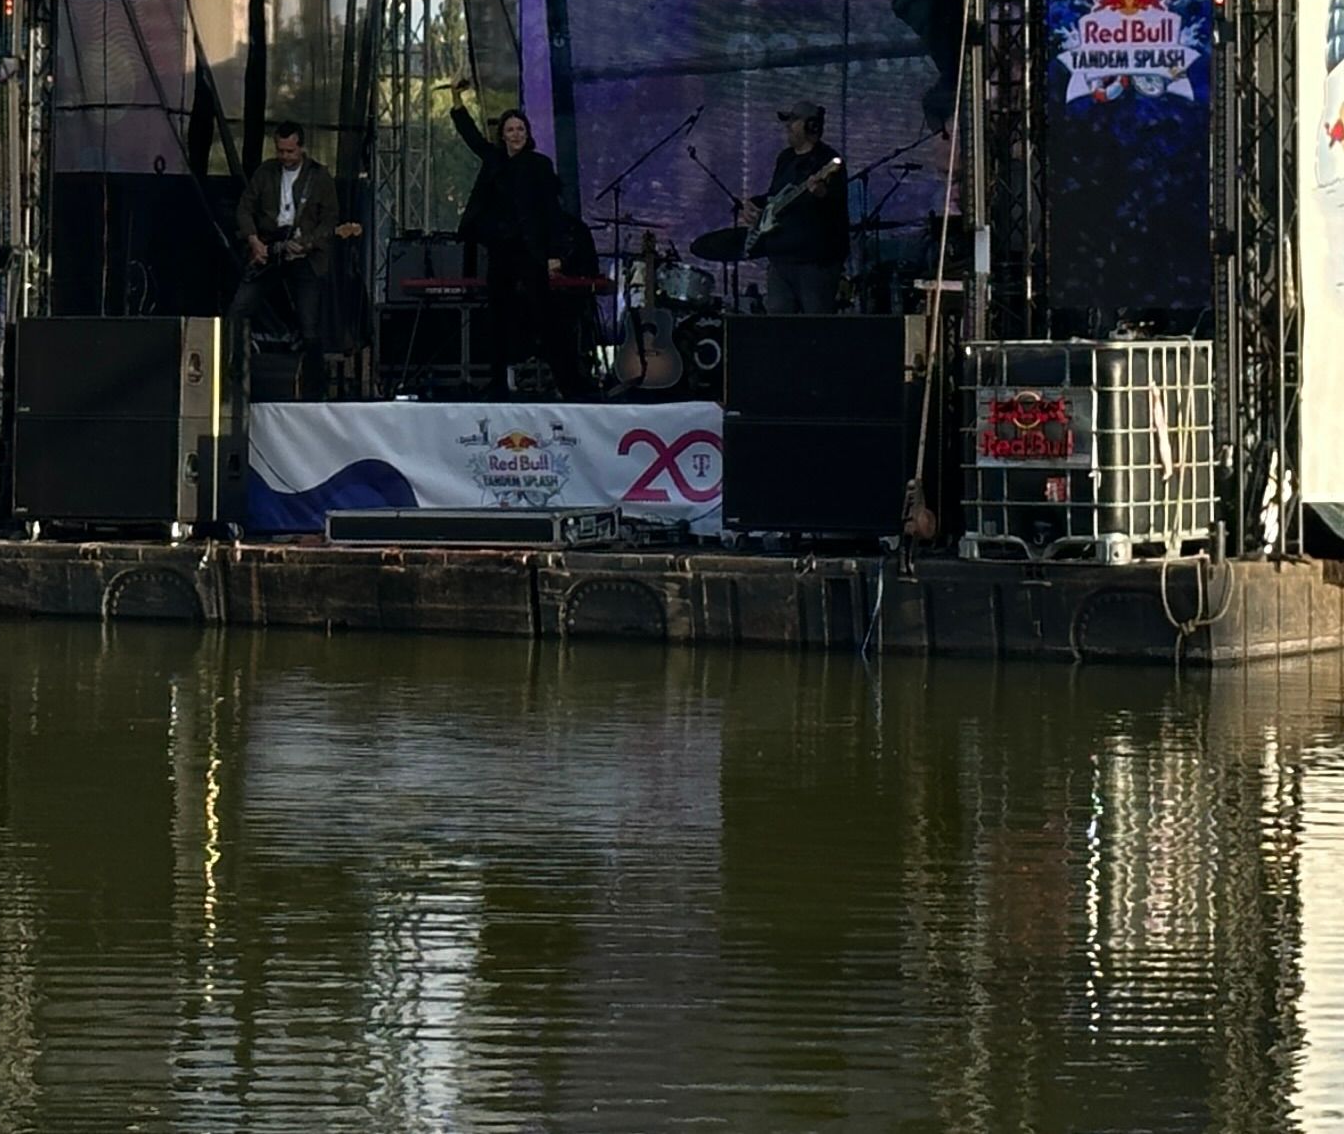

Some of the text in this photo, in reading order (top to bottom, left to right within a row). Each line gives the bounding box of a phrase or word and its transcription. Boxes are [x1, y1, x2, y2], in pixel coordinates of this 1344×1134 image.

[1085, 18, 1173, 43] Red Bull
[1072, 49, 1185, 69] TANDEM SPLASH
[489, 454, 548, 471] Red Bull
